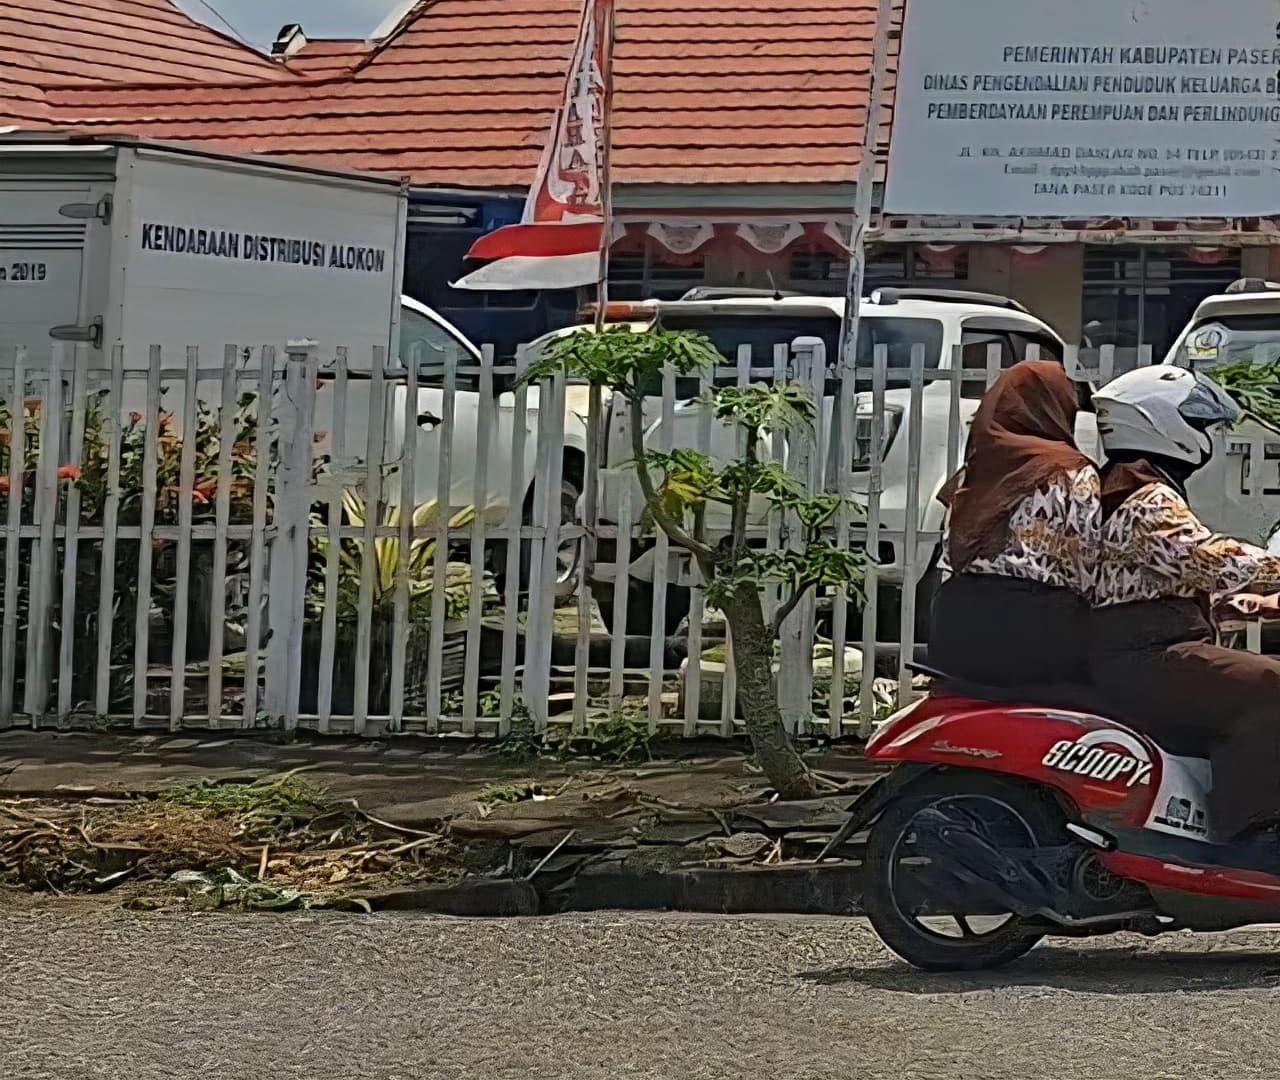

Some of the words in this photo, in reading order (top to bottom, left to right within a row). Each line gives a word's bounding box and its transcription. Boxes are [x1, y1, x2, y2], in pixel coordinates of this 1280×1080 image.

[1002, 45, 1113, 65] PEMERINTAH
[1119, 46, 1221, 65] KABUPATEN
[923, 74, 968, 91] DINAS
[973, 74, 1088, 92] PENGENDALIAN
[1093, 75, 1175, 94] PENDUDUK
[1180, 76, 1261, 94] KELUARGA
[927, 103, 1047, 120] PEMBERDAYAAN
[1051, 104, 1144, 121] PEREMPUAN
[1147, 105, 1179, 121] DAN
[141, 222, 239, 259] KENDARAAN
[243, 234, 326, 268] DISTRIBUSI
[329, 244, 385, 272] ALOKON
[11, 262, 47, 281] 2019
[1041, 739, 1153, 788] SCOOPY
